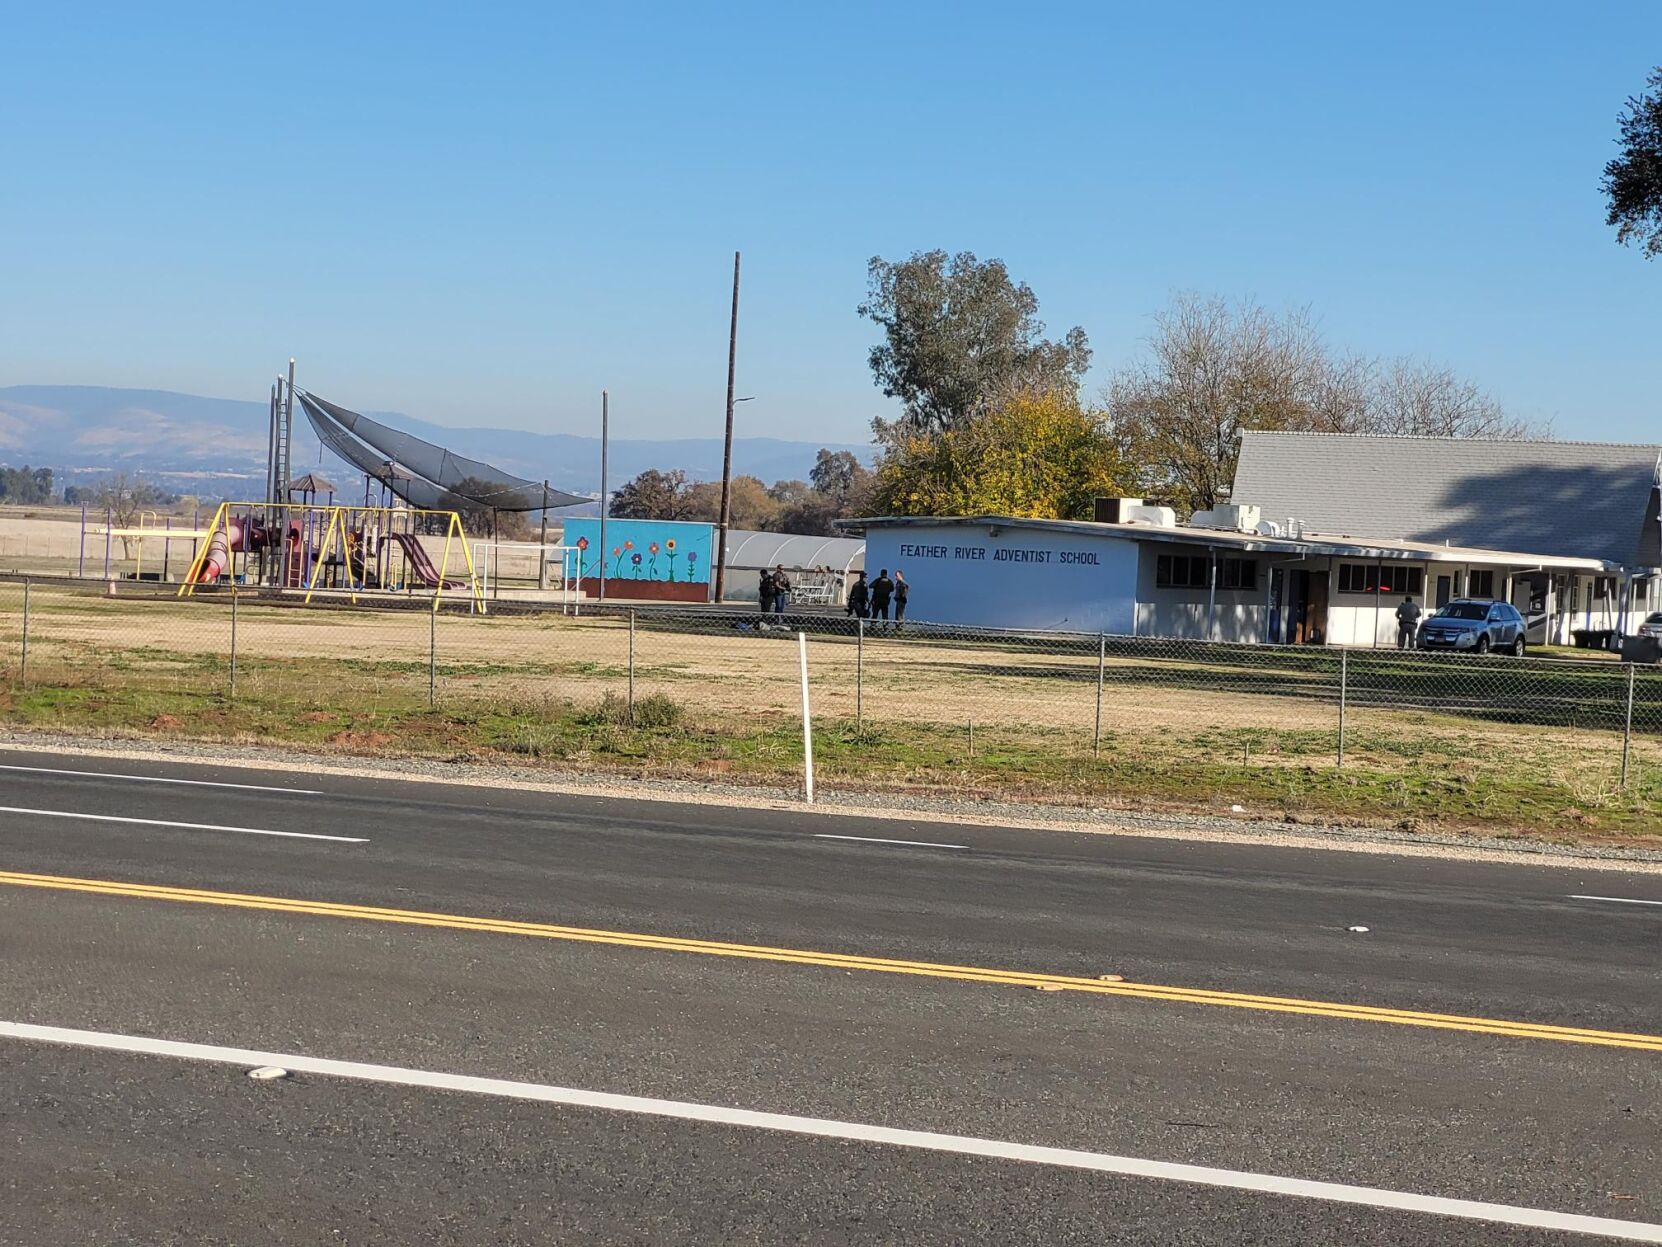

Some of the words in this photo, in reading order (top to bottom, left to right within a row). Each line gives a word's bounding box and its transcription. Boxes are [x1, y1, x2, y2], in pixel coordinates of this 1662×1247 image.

[900, 544, 948, 559] FEATHER
[954, 547, 985, 560] RIVER
[993, 548, 1052, 563] ADVENTIST
[1059, 551, 1100, 565] SCHOOL
